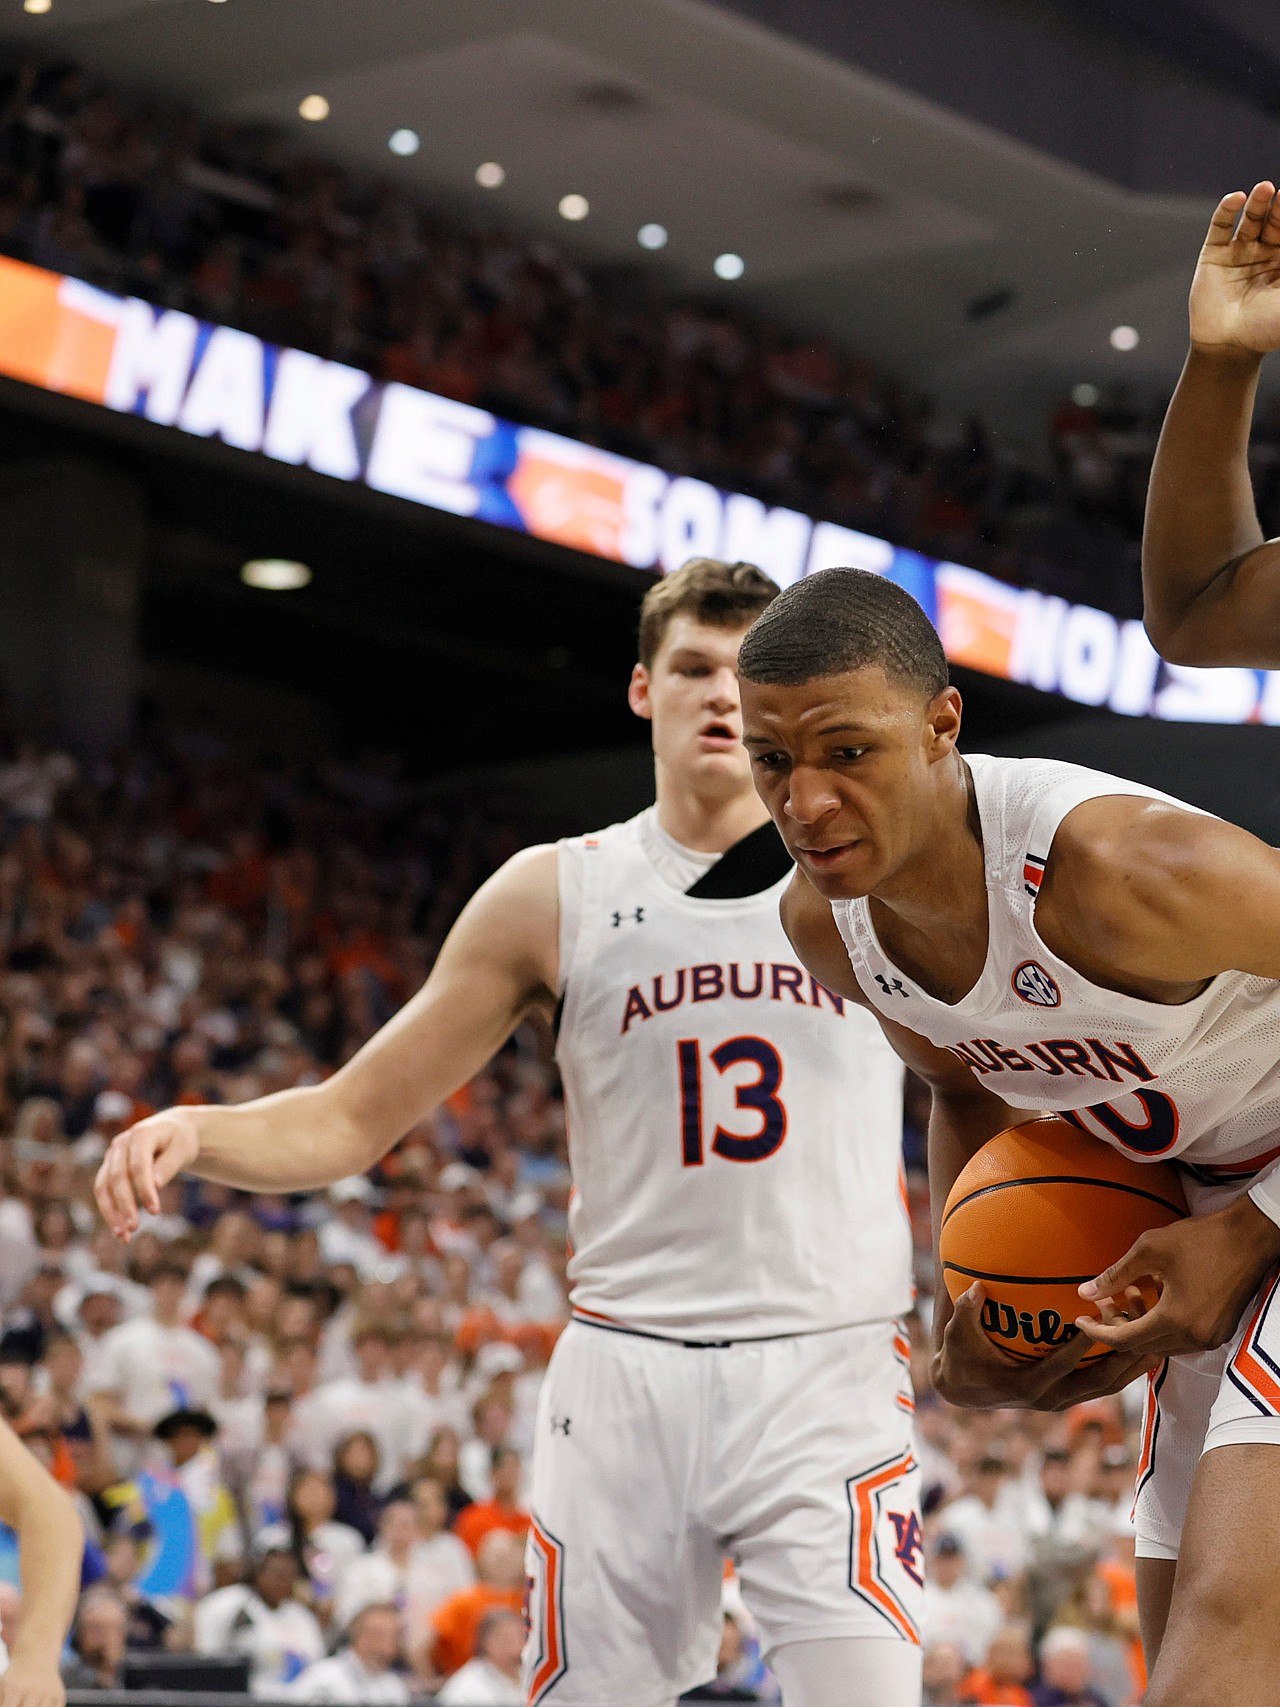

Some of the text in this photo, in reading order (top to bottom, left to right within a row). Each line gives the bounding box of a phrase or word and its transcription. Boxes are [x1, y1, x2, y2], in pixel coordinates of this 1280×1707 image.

[105, 296, 497, 517] MAKE
[1015, 963, 1059, 1006] SEC
[677, 1034, 787, 1168] 13
